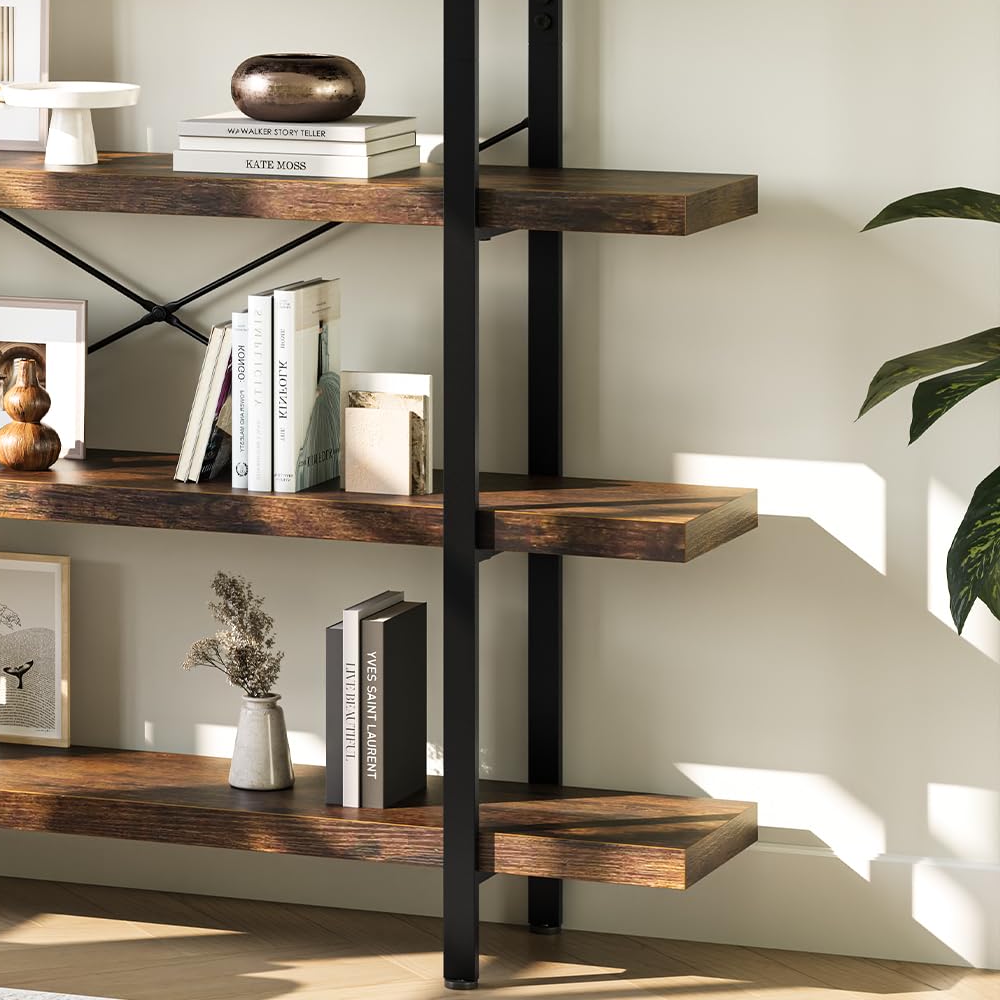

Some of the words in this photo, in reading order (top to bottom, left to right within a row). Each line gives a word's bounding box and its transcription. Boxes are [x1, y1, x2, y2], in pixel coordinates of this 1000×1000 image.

[274, 128, 298, 136] STORY
[301, 130, 326, 138] TELLER
[246, 160, 274, 170] KATE
[277, 160, 306, 170] MOSS
[346, 663, 356, 690] LIVE
[366, 651, 376, 682] YVES
[366, 685, 376, 722] SAINT
[346, 693, 356, 762] BEAUTIFUL
[366, 724, 376, 780] LAURENT
